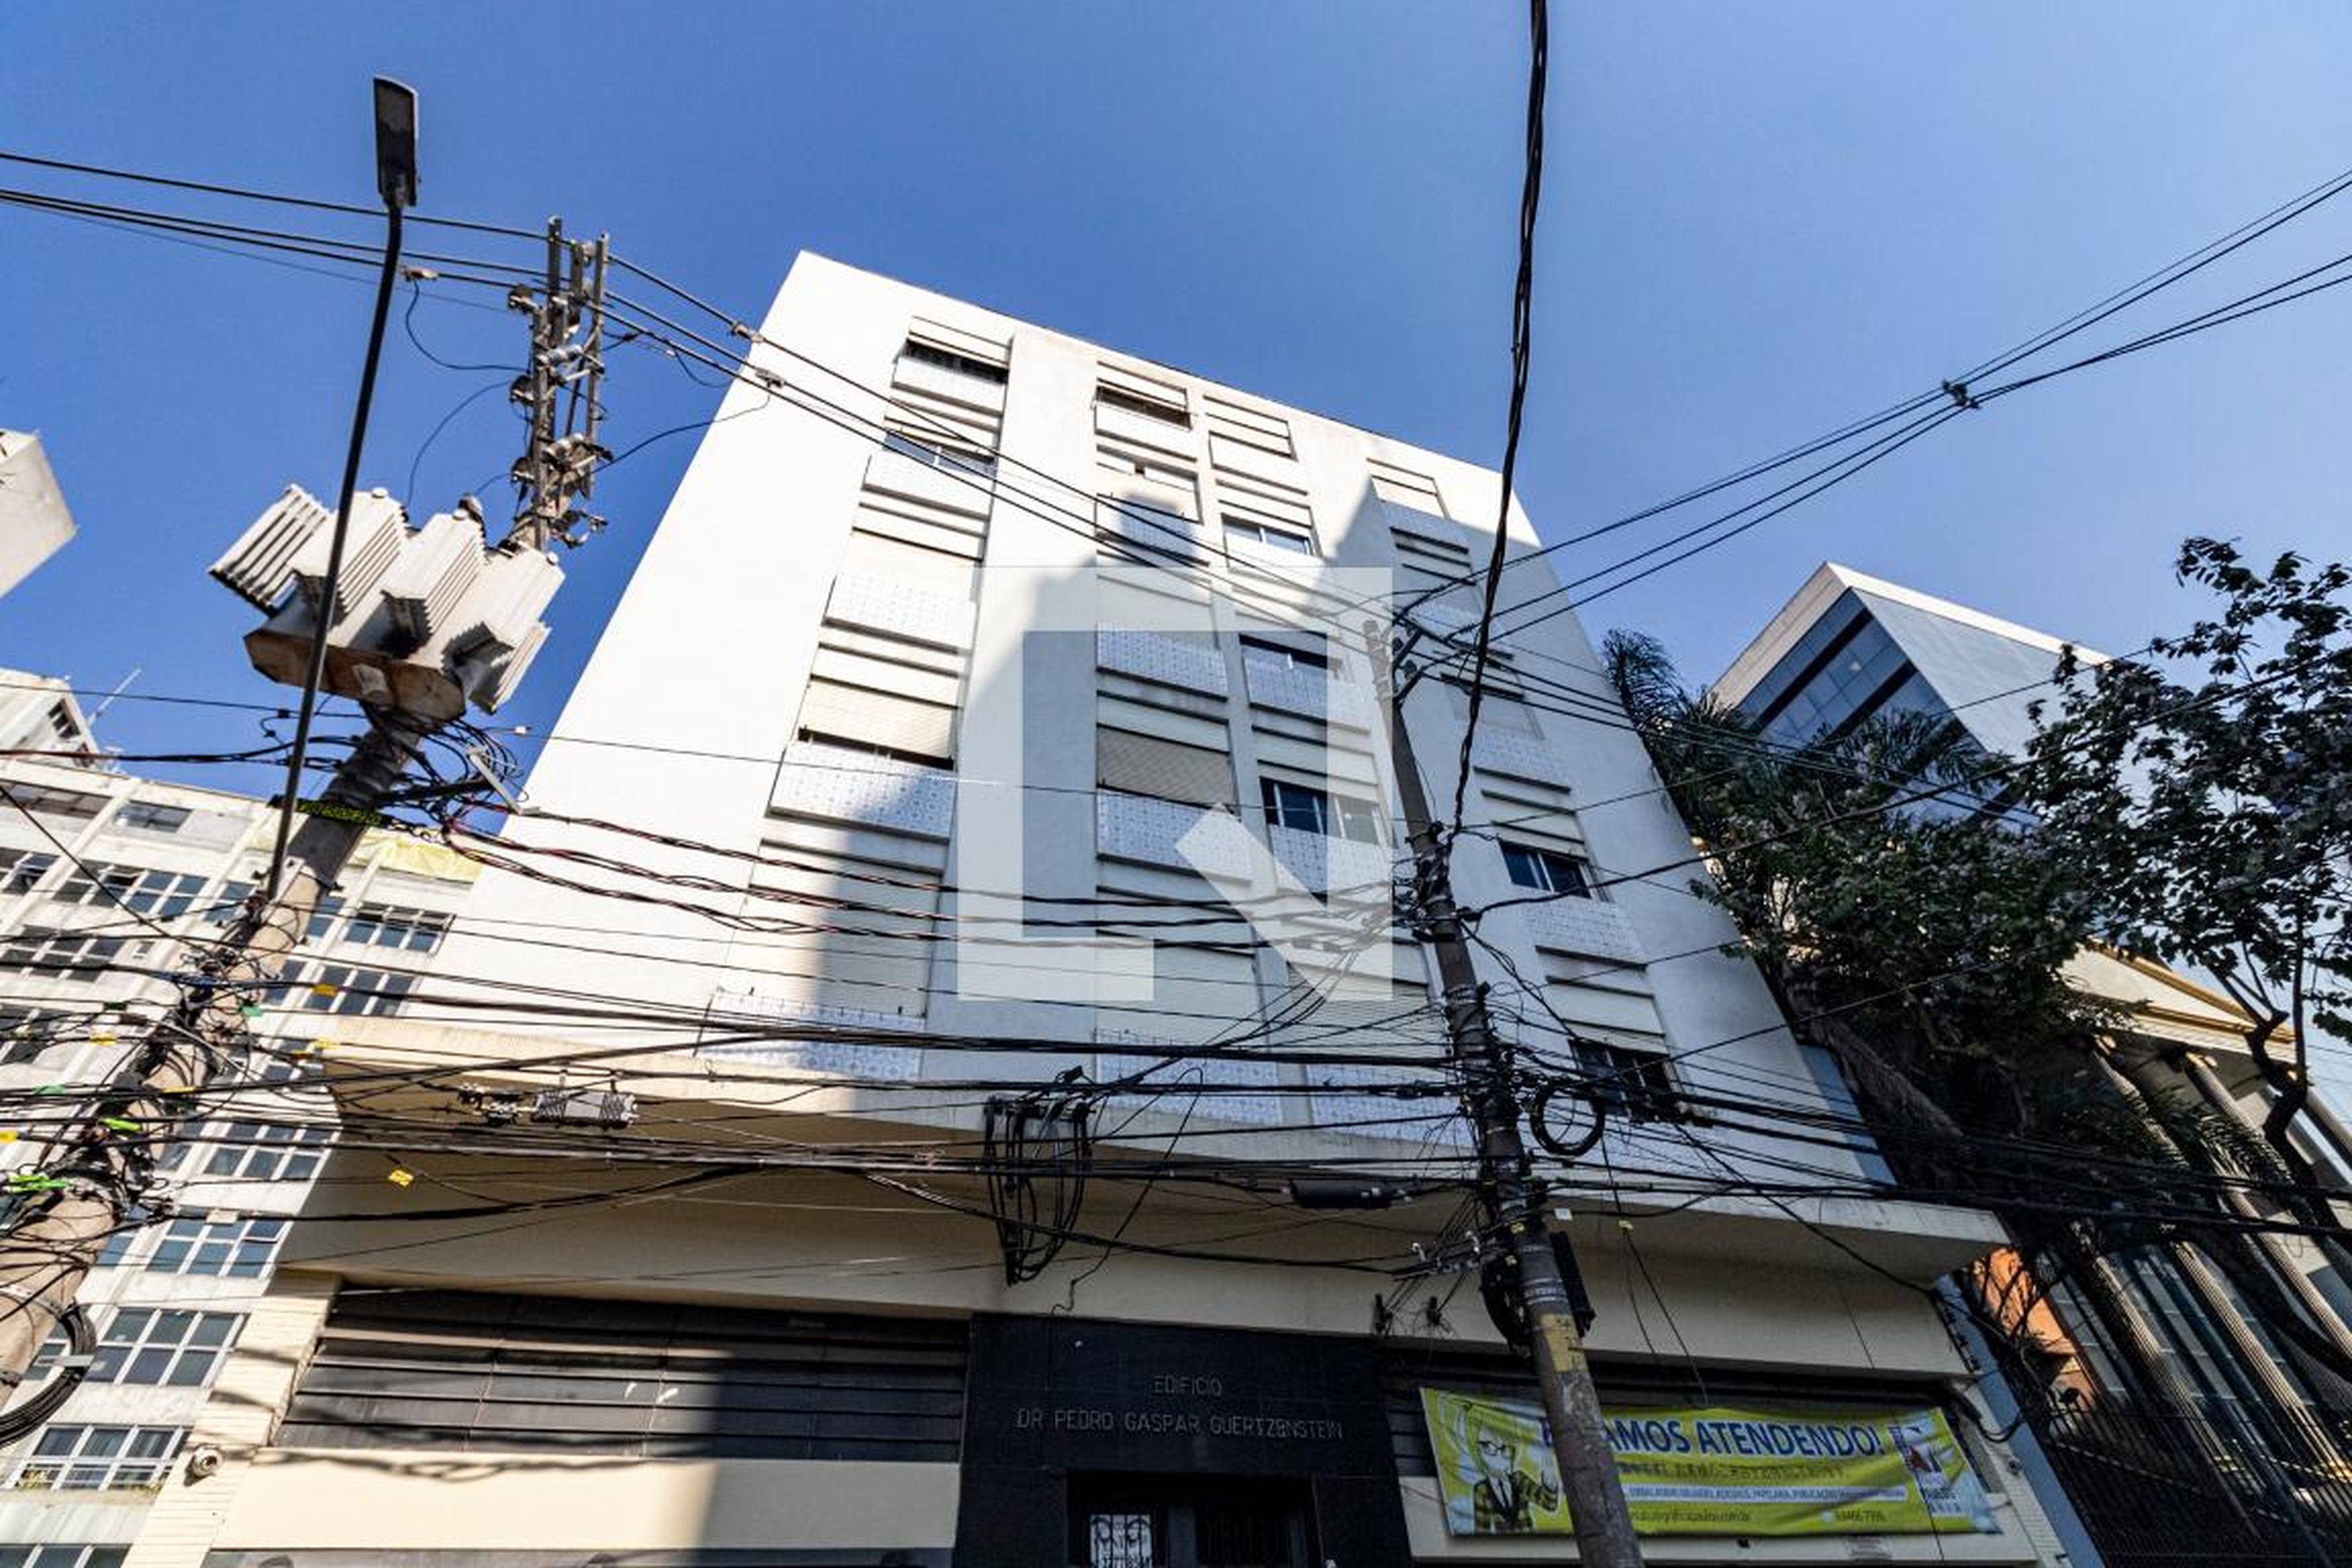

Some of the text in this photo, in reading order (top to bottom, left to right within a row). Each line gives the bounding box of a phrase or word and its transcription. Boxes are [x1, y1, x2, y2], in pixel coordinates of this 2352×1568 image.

[1153, 1376, 1223, 1396] EDIFICIO
[1016, 1408, 1042, 1428] DR
[1054, 1409, 1113, 1432] PEDRO
[1125, 1411, 1200, 1434] GASPAR
[1695, 1422, 1884, 1457] ATENDENDO!
